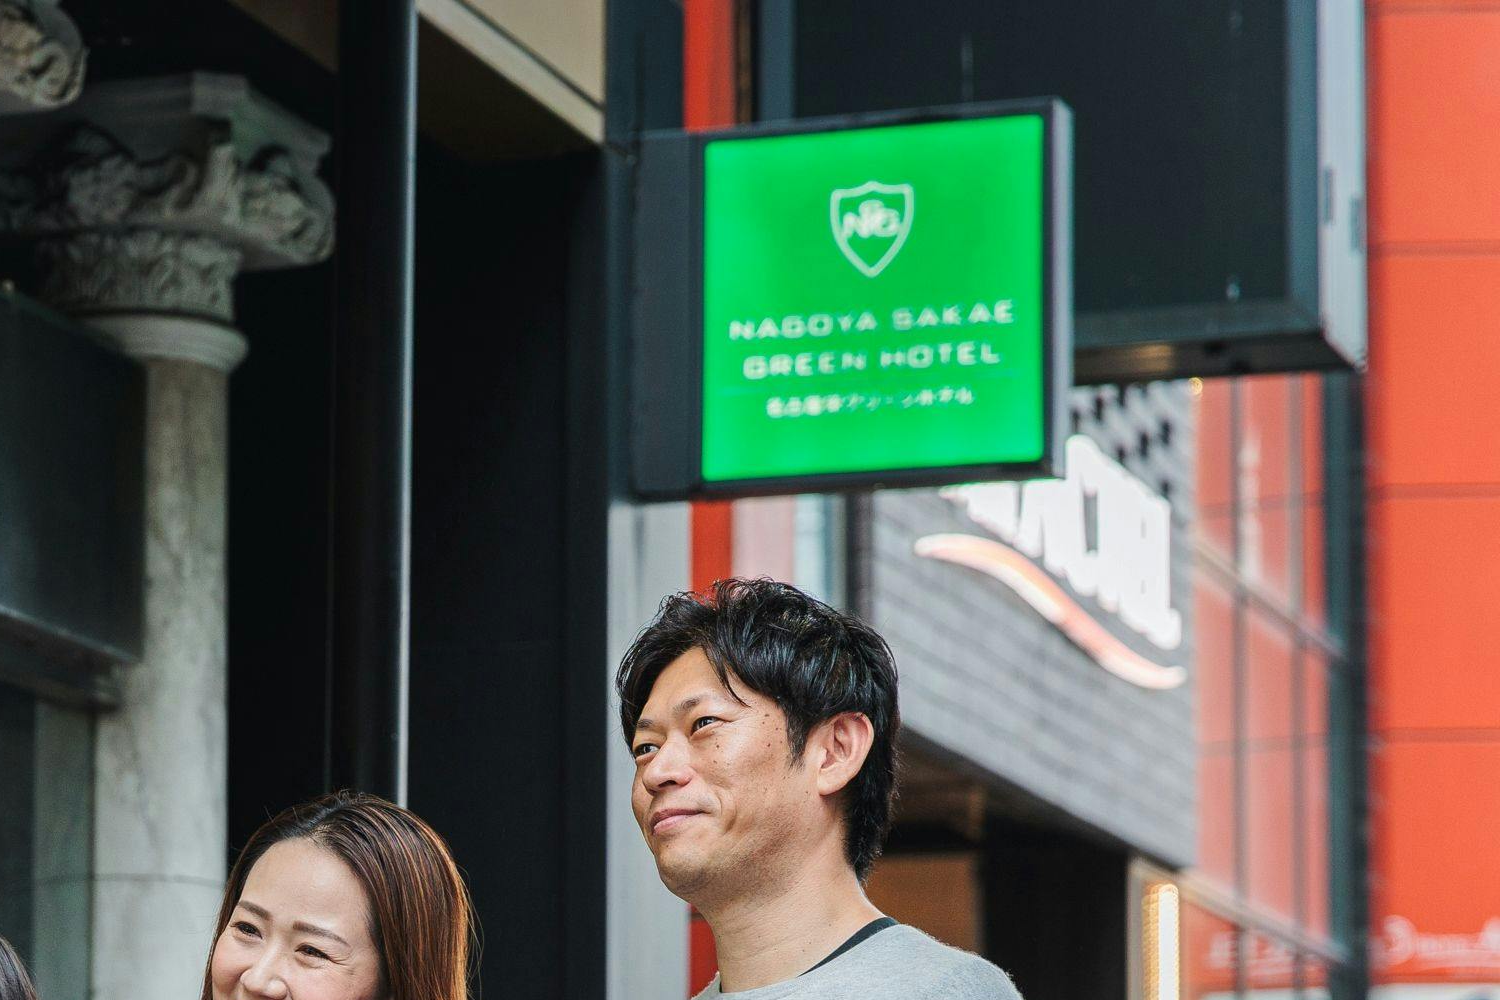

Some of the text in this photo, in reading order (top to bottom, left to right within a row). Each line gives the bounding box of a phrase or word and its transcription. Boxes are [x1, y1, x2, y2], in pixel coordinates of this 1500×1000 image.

[729, 299, 1014, 340] NAGOYA SAKAE
[743, 341, 1001, 380] GREEN HOTEL
